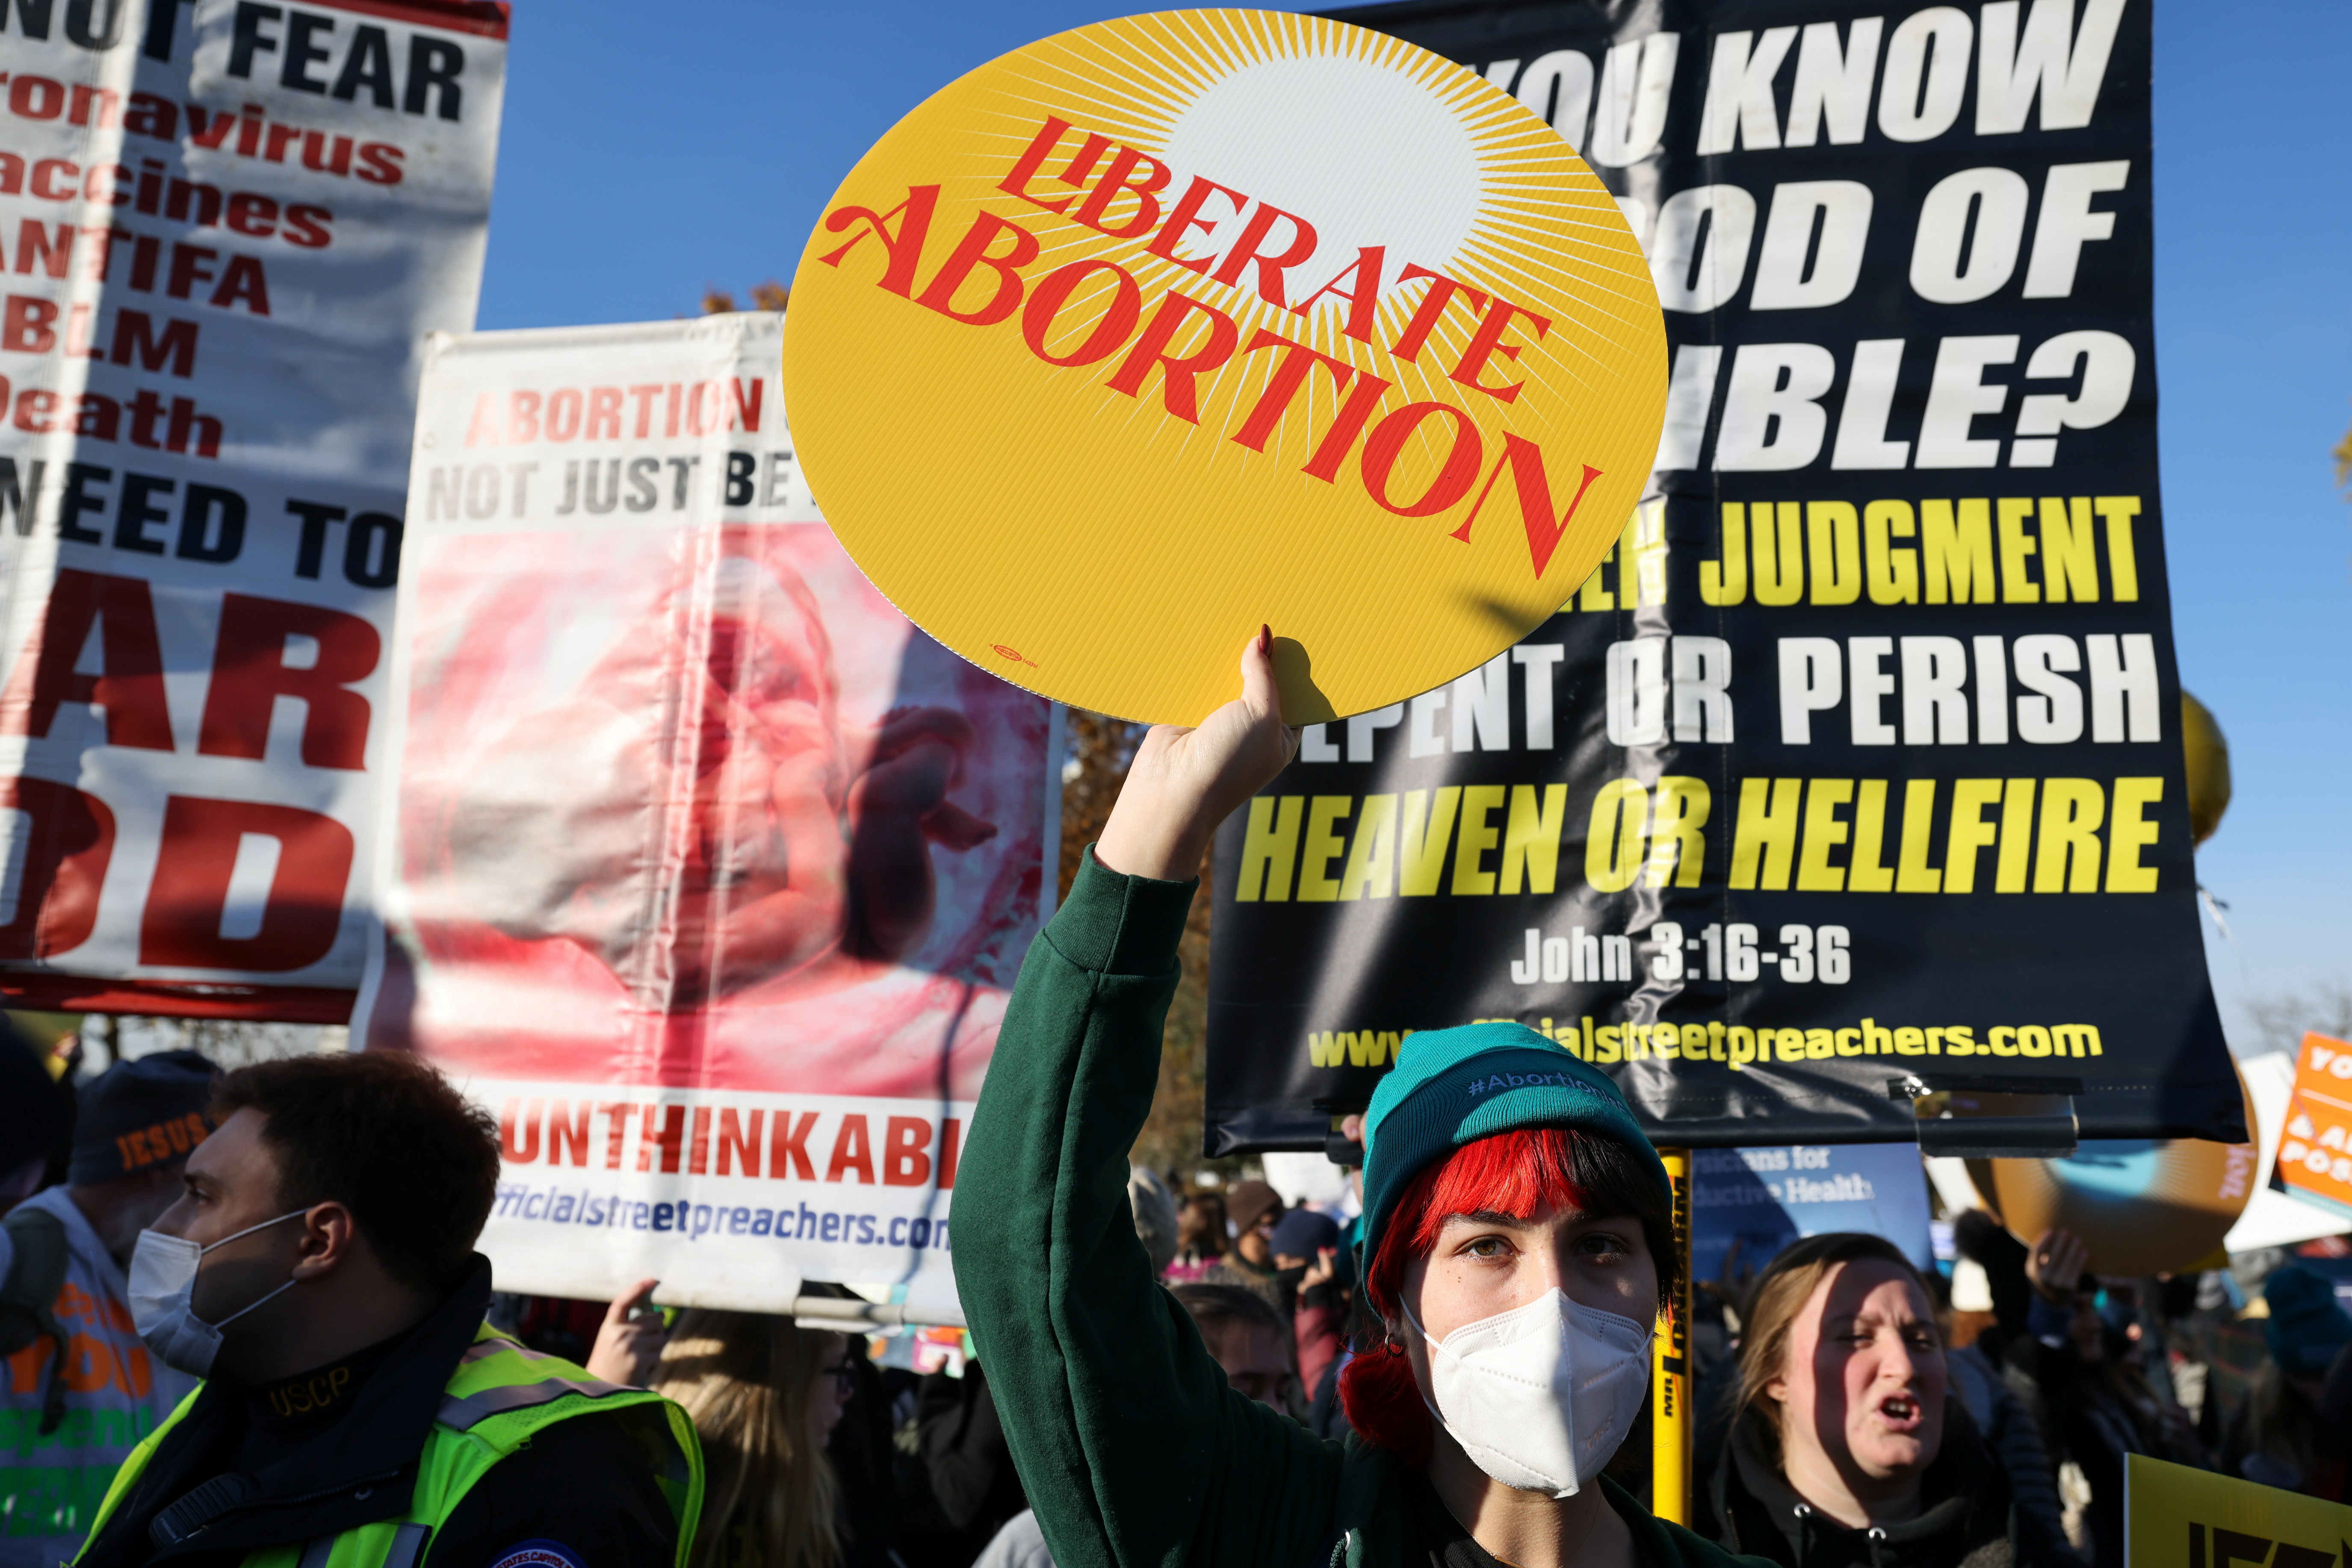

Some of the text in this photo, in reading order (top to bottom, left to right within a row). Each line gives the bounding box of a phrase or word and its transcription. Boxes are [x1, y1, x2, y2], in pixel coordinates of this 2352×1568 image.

[226, 2, 467, 123] FEAR
[1696, 0, 2127, 156] KNOW
[0, 71, 406, 186] onavirus
[0, 218, 271, 317] NTIFA
[996, 114, 1553, 405] LIBERATE
[1909, 160, 2131, 304] OF
[1, 294, 199, 379] BLM
[0, 372, 224, 460] eath
[464, 376, 764, 449] ABORTION
[817, 184, 1604, 580] ABORTION
[426, 451, 792, 521] NOT JUST BE
[285, 499, 405, 590] TO
[1699, 495, 2142, 607] JUDGMENT
[1022, 659, 1038, 669] 1433M
[1604, 635, 1734, 747] OR
[1778, 633, 2162, 747] PERISH
[1235, 776, 2164, 903] HEAVEN OR HELLFIRE
[1511, 921, 1851, 985] John 3:16-36
[115, 1112, 209, 1172] JESUS
[1791, 1145, 1831, 1170] for
[1784, 1171, 1875, 1204] Health
[269, 1367, 350, 1417] USCP
[530, 1552, 565, 1568] CAPITOL
